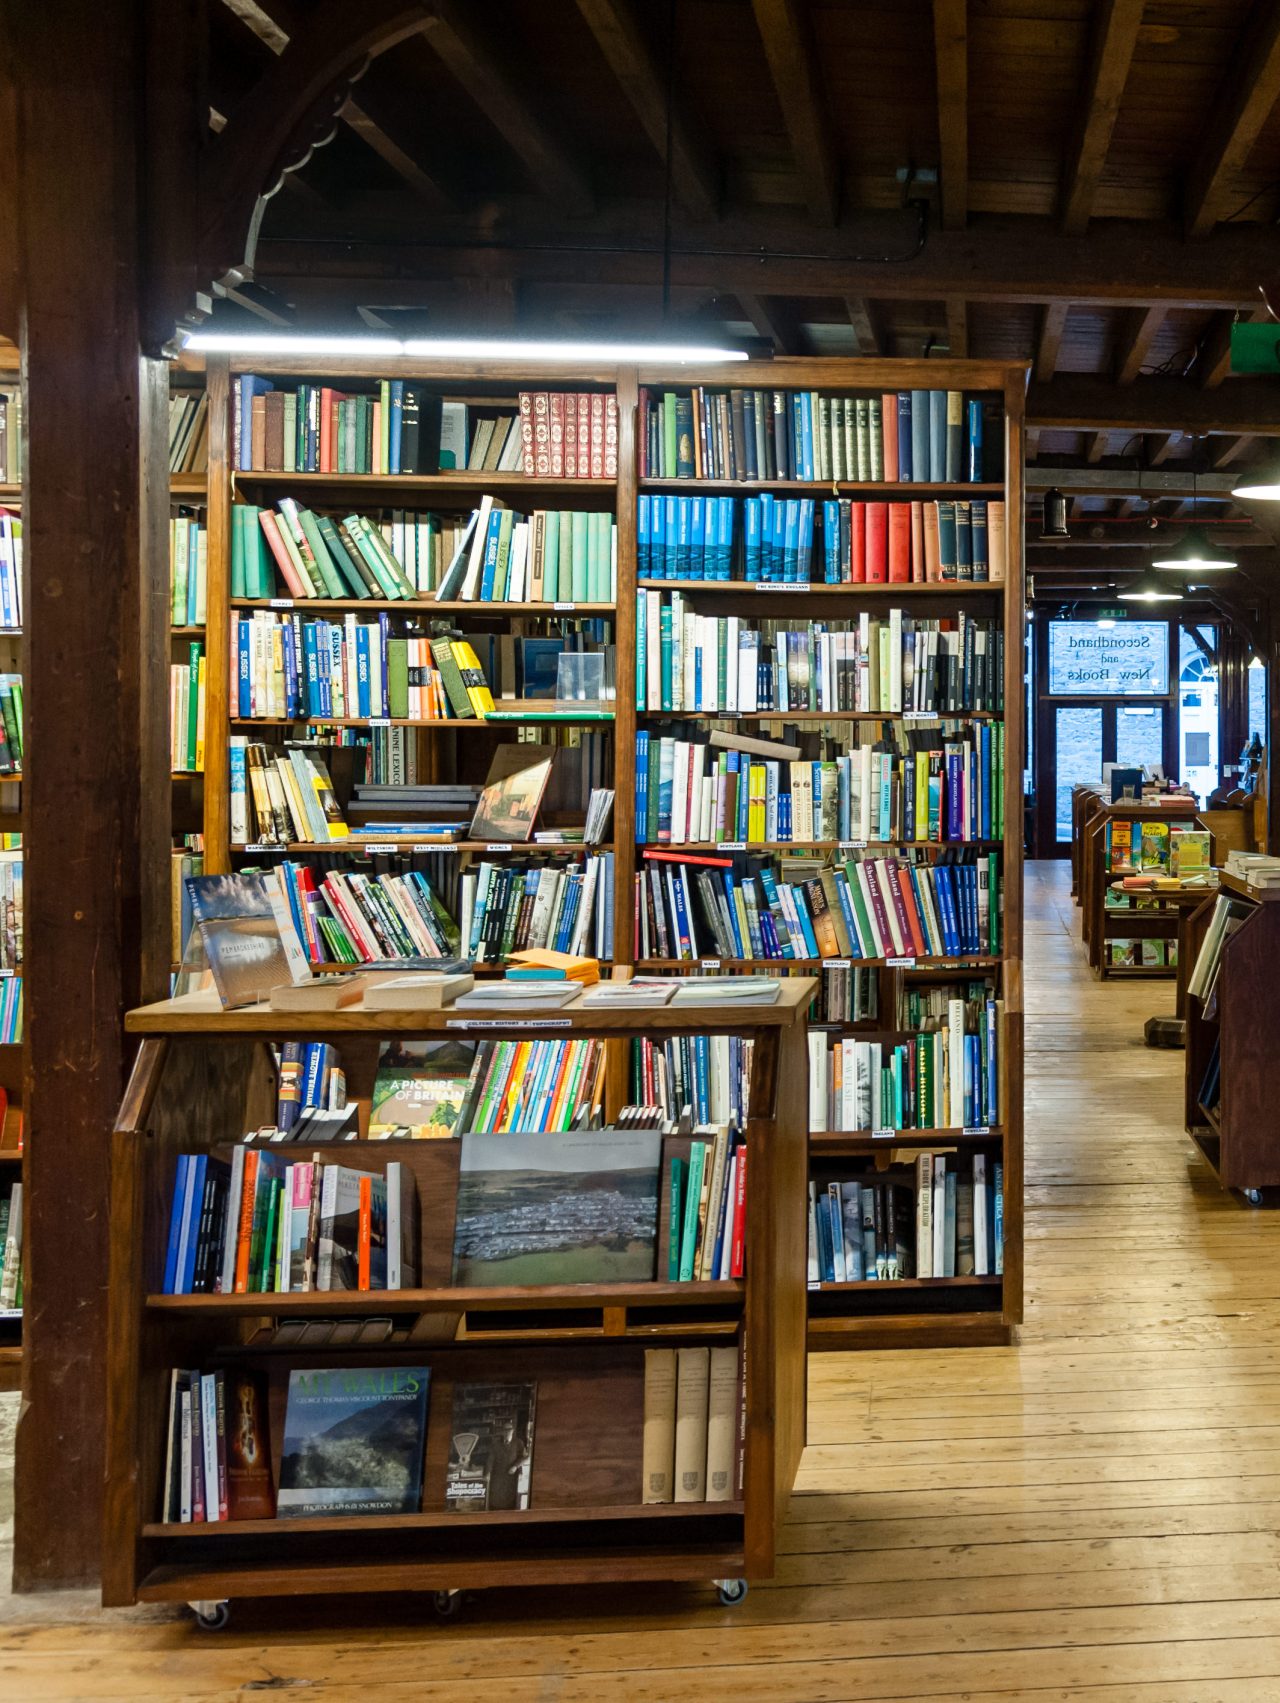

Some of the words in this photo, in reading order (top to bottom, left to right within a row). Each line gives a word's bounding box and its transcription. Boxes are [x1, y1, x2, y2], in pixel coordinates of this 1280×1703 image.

[486, 536, 498, 566] SUSSEX
[497, 540, 507, 569] SUSSEX
[331, 631, 340, 667] SUSSEX
[637, 631, 645, 664] IRELAND
[239, 650, 248, 679] SUSSEX
[307, 652, 317, 682] SUSSEX
[357, 653, 366, 682] SUSSEX
[865, 864, 879, 897] Shetland
[886, 863, 900, 896] Shetland
[308, 1051, 319, 1078] REMOTE
[304, 1079, 315, 1105] BRITAIN
[390, 1080, 399, 1089] A
[402, 1080, 454, 1090] PICTURE
[395, 1090, 412, 1100] OF
[414, 1090, 465, 1100] BRITAIN
[921, 1169, 930, 1183] BOOK
[994, 1167, 1003, 1219] ANTARCTICA
[921, 1193, 930, 1226] EXPLORATION
[343, 1371, 420, 1394] WALES
[182, 1408, 190, 1439] Mimosa
[450, 1482, 466, 1490] Tales
[358, 1502, 393, 1510] SNOWDON
